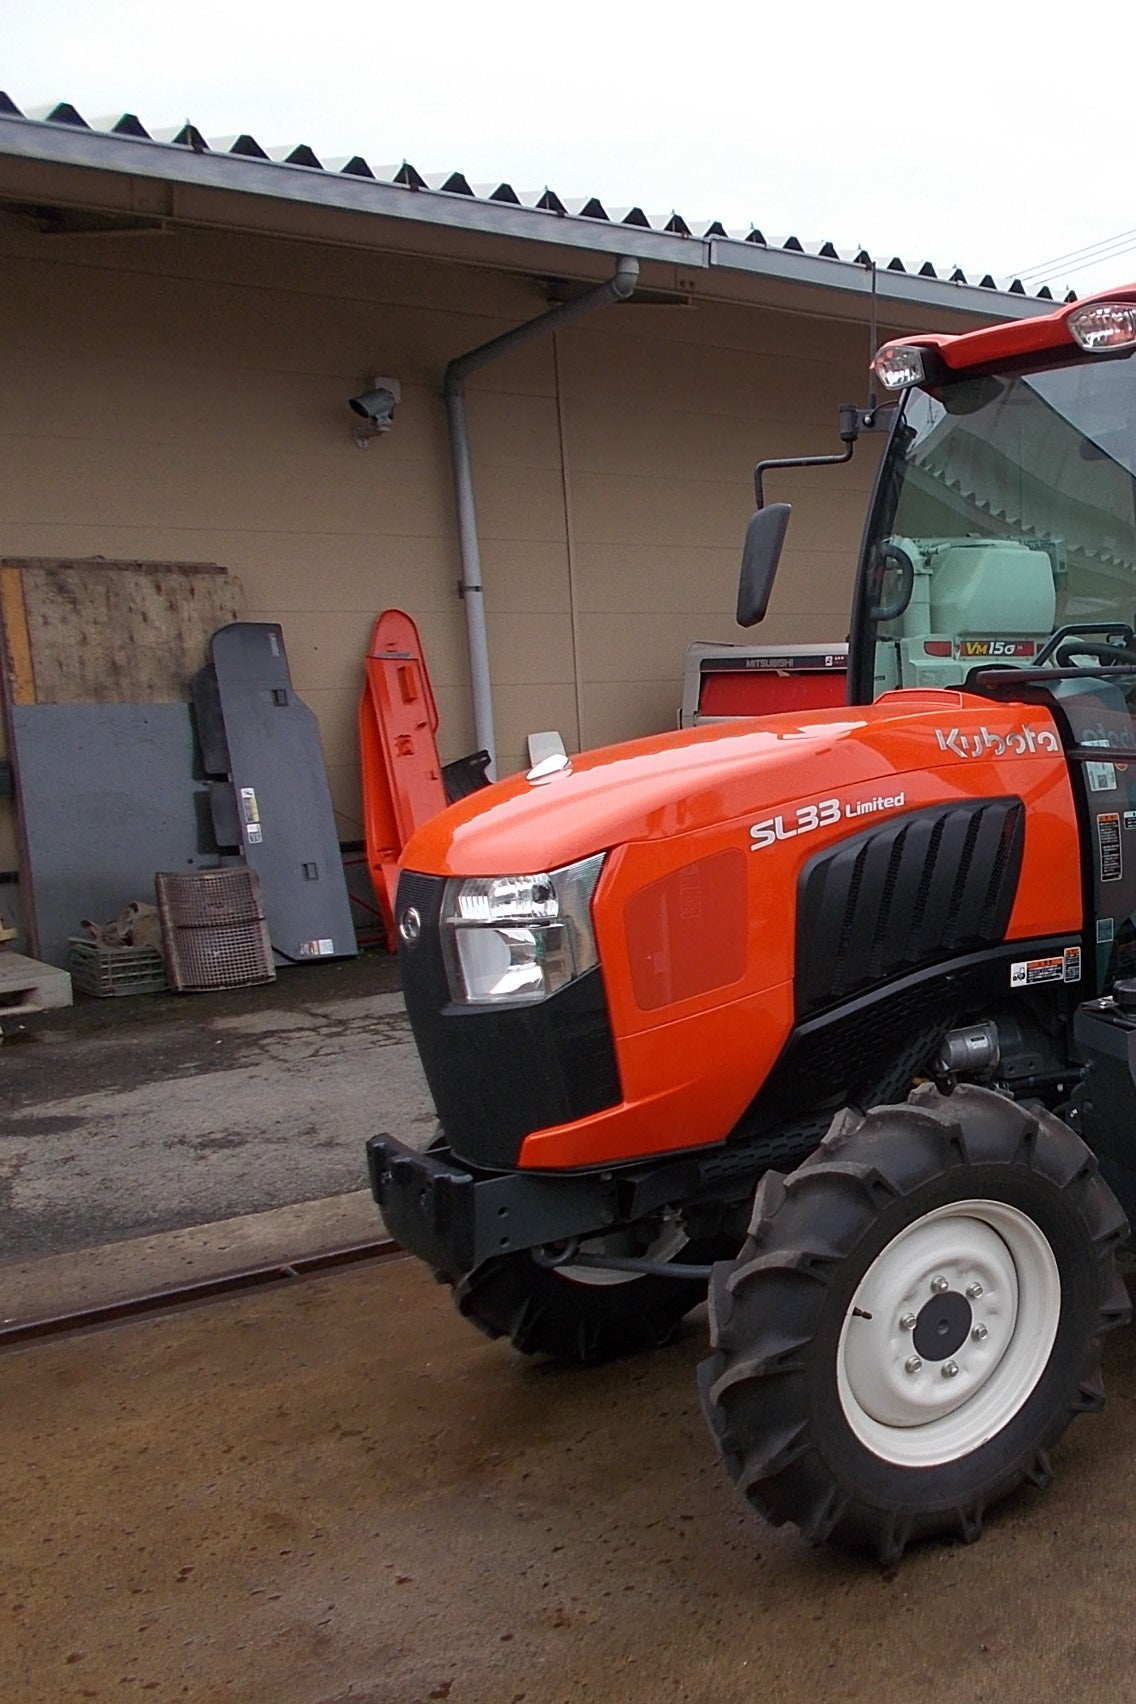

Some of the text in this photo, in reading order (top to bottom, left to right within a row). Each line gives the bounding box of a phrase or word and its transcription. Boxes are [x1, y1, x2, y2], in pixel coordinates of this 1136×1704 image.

[746, 658, 794, 668] MITSUBISHI
[935, 724, 1059, 758] Kubota
[749, 792, 905, 851] SL33 Limited
